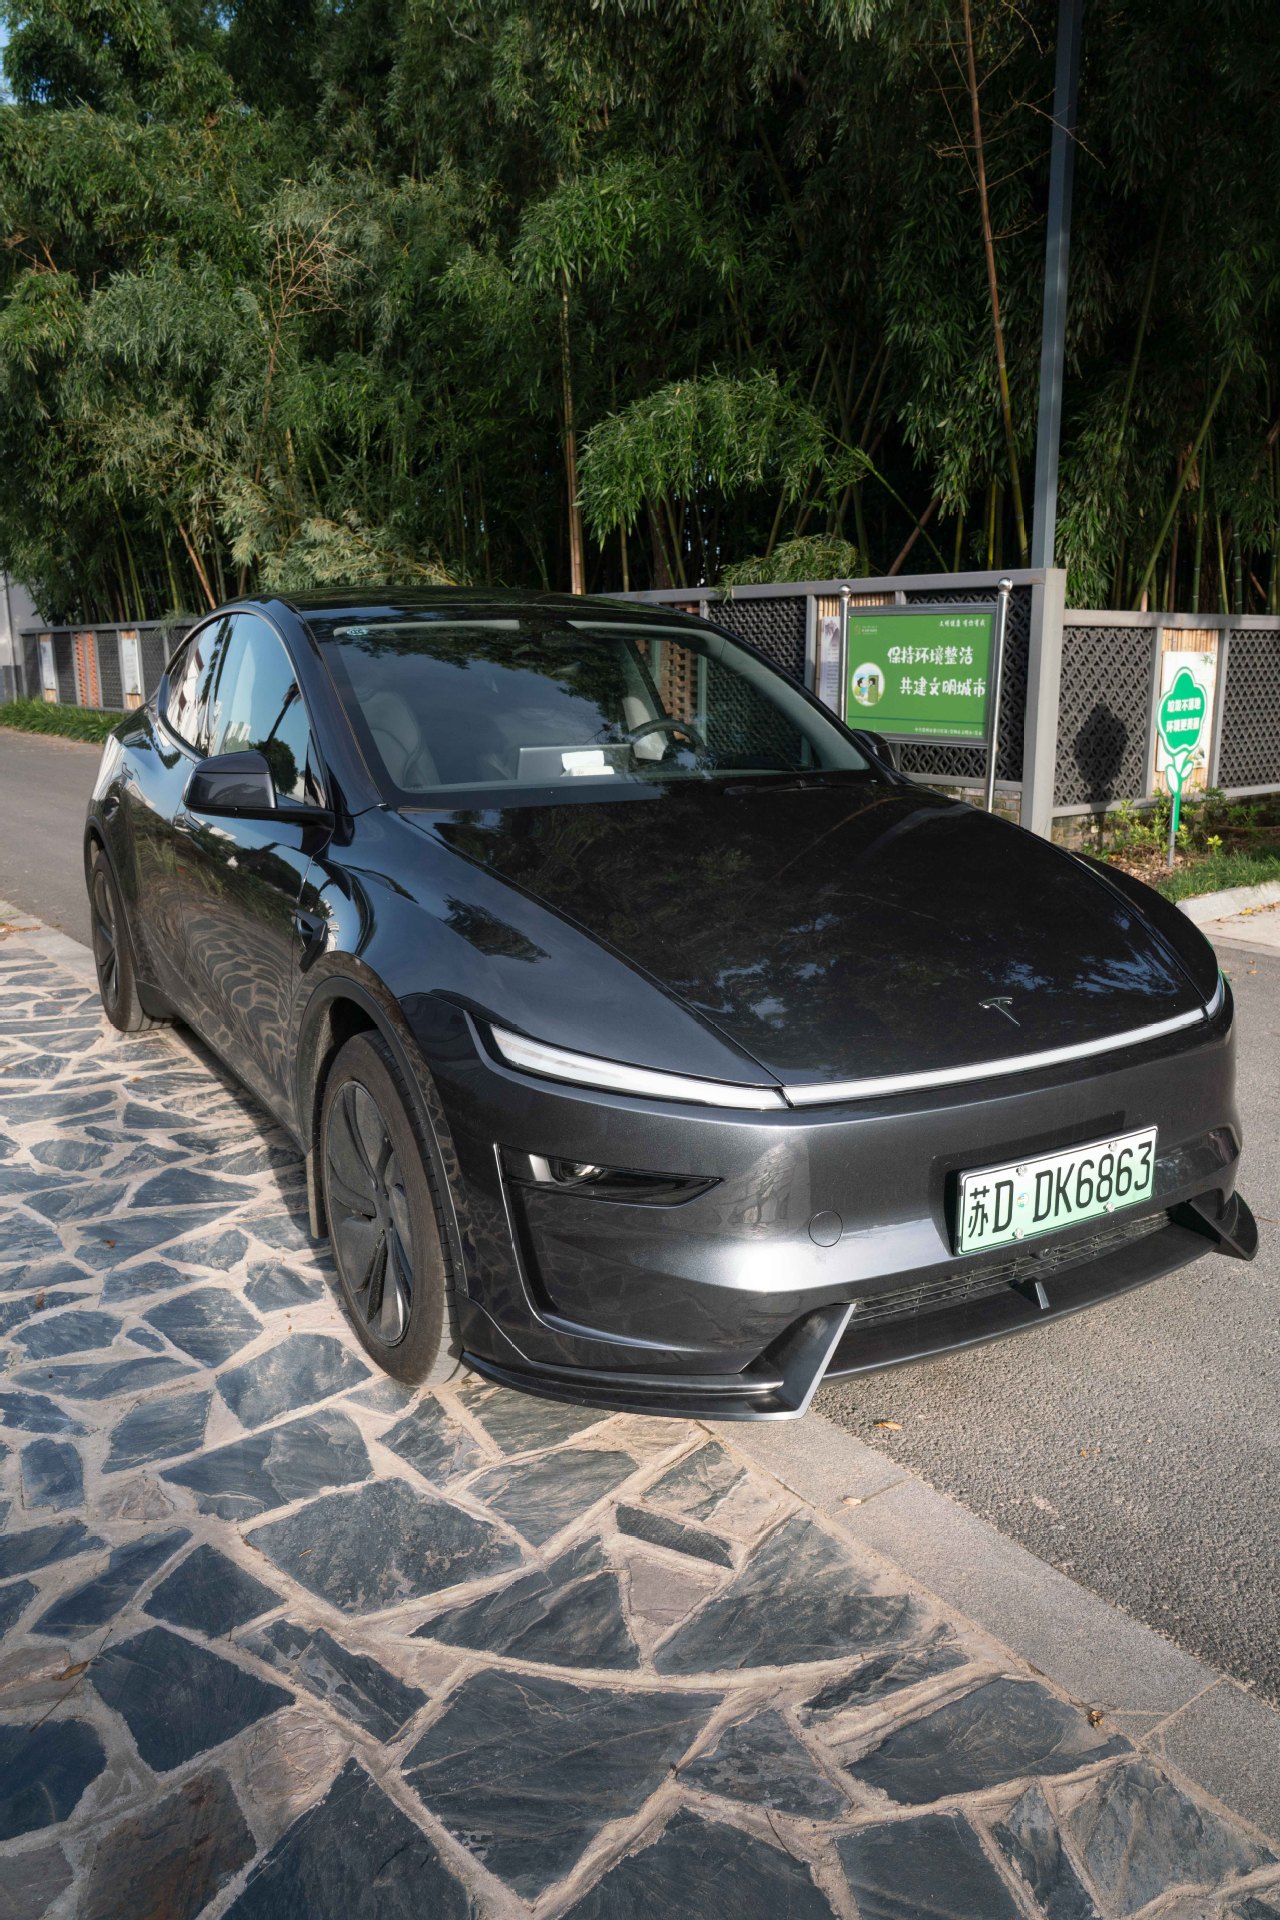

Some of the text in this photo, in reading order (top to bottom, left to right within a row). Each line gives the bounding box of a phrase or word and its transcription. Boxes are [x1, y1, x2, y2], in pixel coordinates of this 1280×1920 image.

[887, 645, 974, 665] 保持环境整洁
[900, 676, 986, 698] 共建文明城市
[1167, 697, 1201, 713] 垃圾不落地
[968, 1140, 1153, 1238] 苏D DK6863
